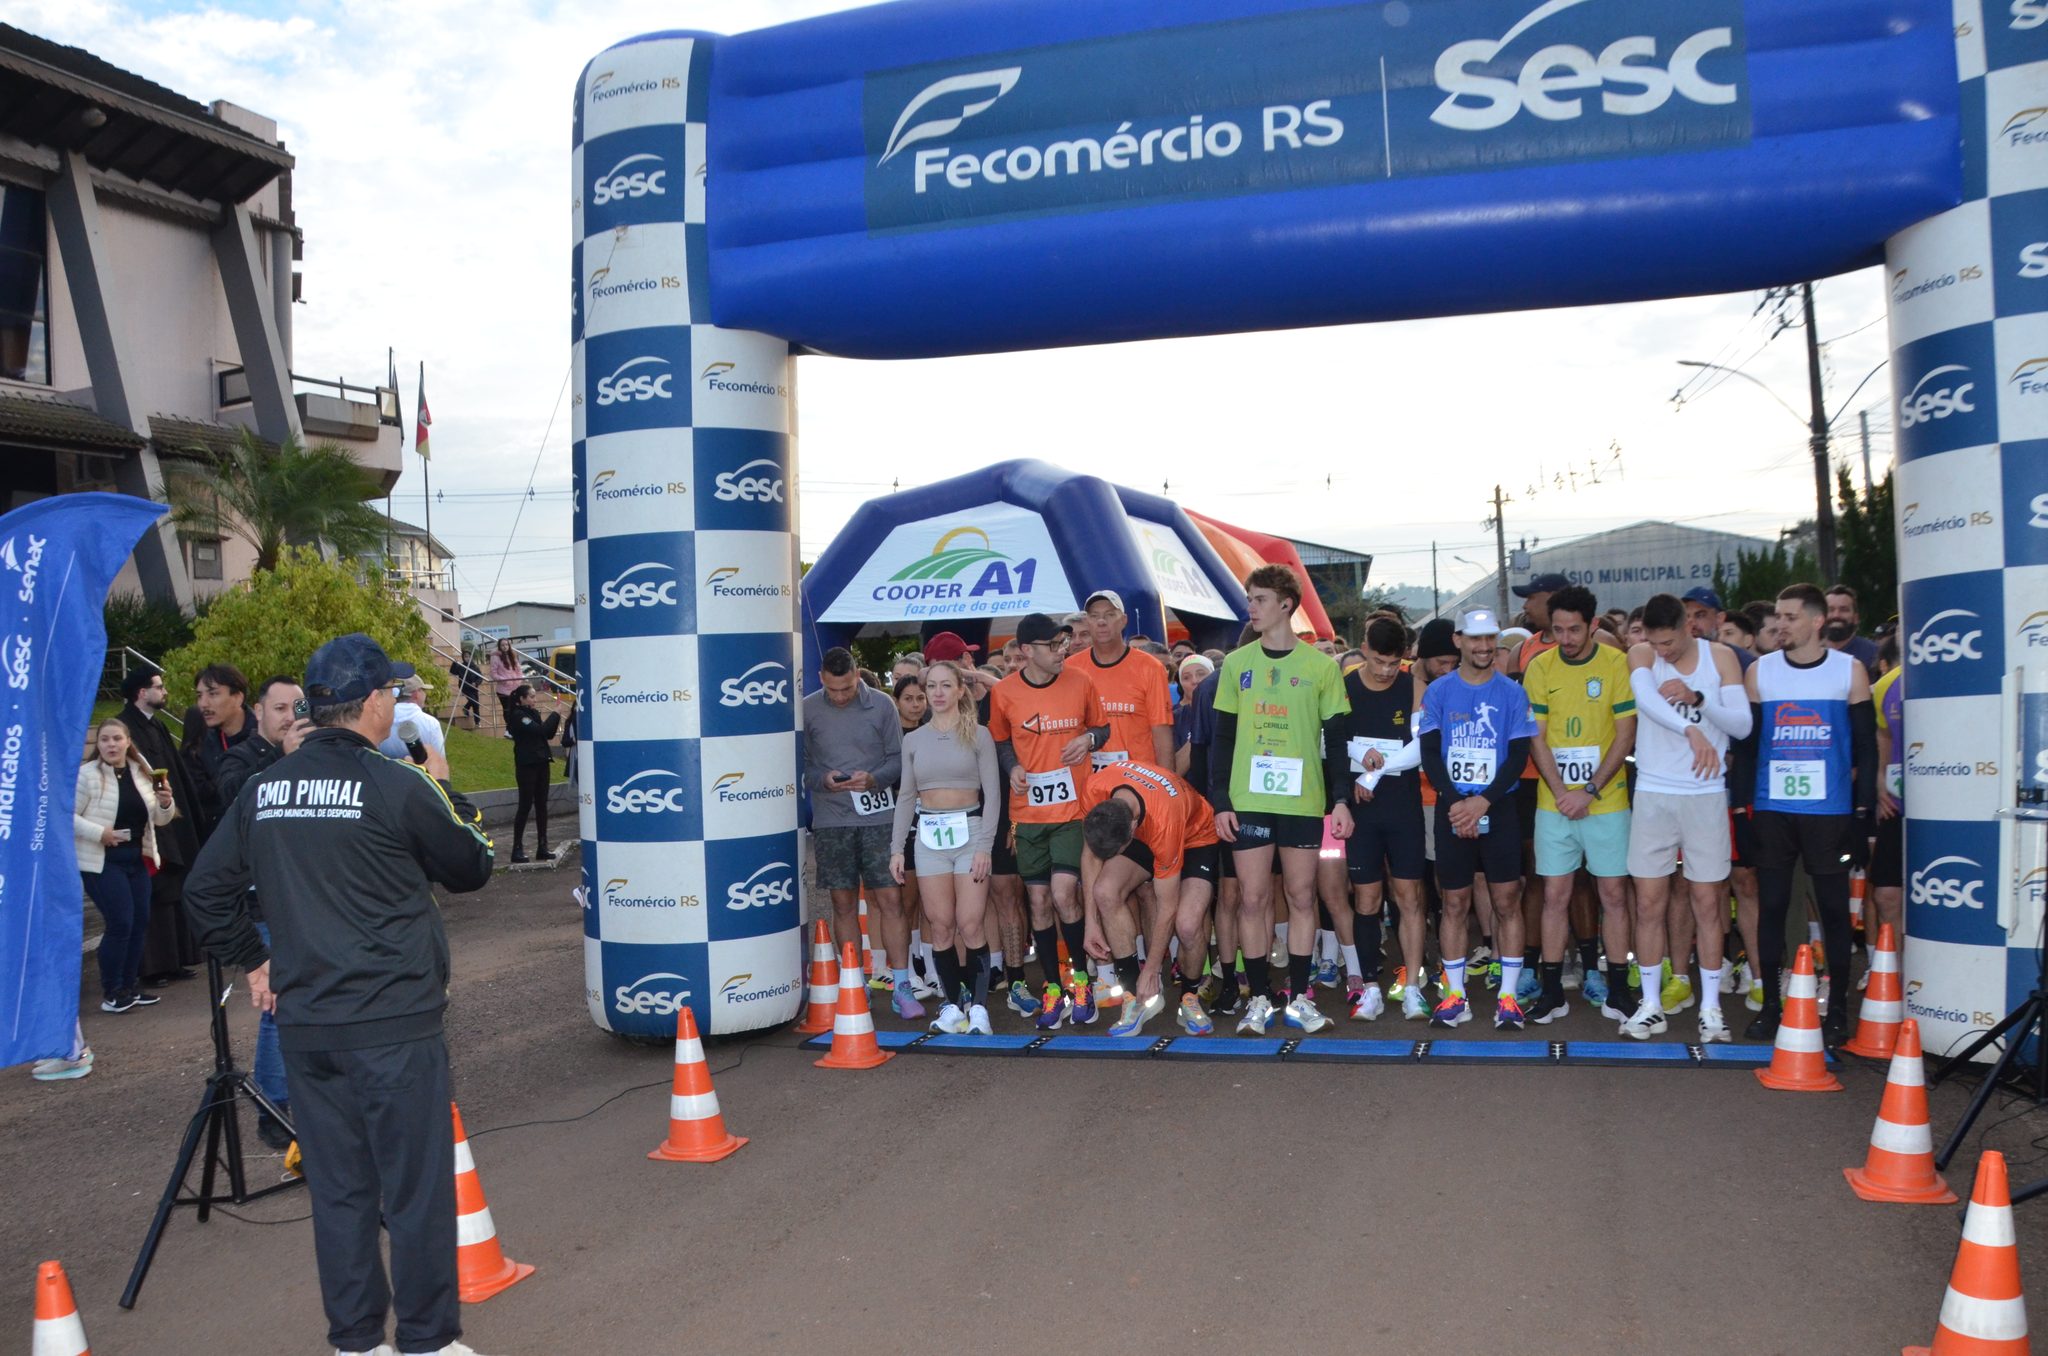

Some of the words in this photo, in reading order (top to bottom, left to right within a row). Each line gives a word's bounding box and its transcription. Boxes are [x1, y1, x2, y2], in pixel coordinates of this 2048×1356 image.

[592, 79, 658, 104] Fecomércio
[661, 77, 681, 89] RS
[914, 115, 1243, 193] Fecomércio
[1262, 99, 1345, 152] RS
[592, 277, 658, 299] Fecomércio
[661, 277, 681, 289] RS
[709, 379, 776, 395] Fecomércio
[777, 385, 787, 398] RS
[596, 482, 663, 501] Fecomércio
[667, 482, 687, 494] RS
[1970, 510, 1993, 527] RS
[872, 583, 963, 601] COOPER
[968, 557, 1037, 597] A1
[1599, 565, 1685, 583] MUNICIPAL
[1690, 564, 1712, 579] 29
[713, 584, 780, 597] Fecomércio
[781, 584, 791, 597] RS
[904, 603, 926, 617] faz
[929, 601, 966, 616] parte
[970, 600, 987, 612] da
[991, 598, 1031, 613] gente
[601, 690, 669, 705] Fecomércio
[672, 690, 692, 702] RS
[1566, 716, 1582, 738] 10
[1772, 725, 1832, 740] JAIME
[1452, 761, 1488, 782] 854
[1557, 762, 1593, 782] 708
[1908, 758, 1971, 776] Fecomércio
[1976, 761, 1998, 776] RS
[1263, 771, 1289, 792] 62
[1784, 775, 1811, 797] 85
[257, 780, 291, 808] CMD
[295, 779, 364, 807] PINHAL
[719, 786, 784, 803] Fecomércio
[785, 784, 795, 796] RS
[860, 790, 889, 811] 939
[1032, 782, 1069, 803] 973
[30, 796, 48, 852] Sistema
[256, 809, 284, 821] CONSELHO
[284, 809, 317, 818] MUNICIPAL
[317, 809, 326, 818] DE
[327, 809, 362, 819] DESPORTO
[933, 826, 955, 846] 11
[608, 893, 676, 908] Fecomércio
[680, 895, 700, 907] RS
[727, 983, 791, 1004] Fecomércio
[1907, 1000, 1968, 1024] Fecomércio
[1973, 1010, 1995, 1027] RS
